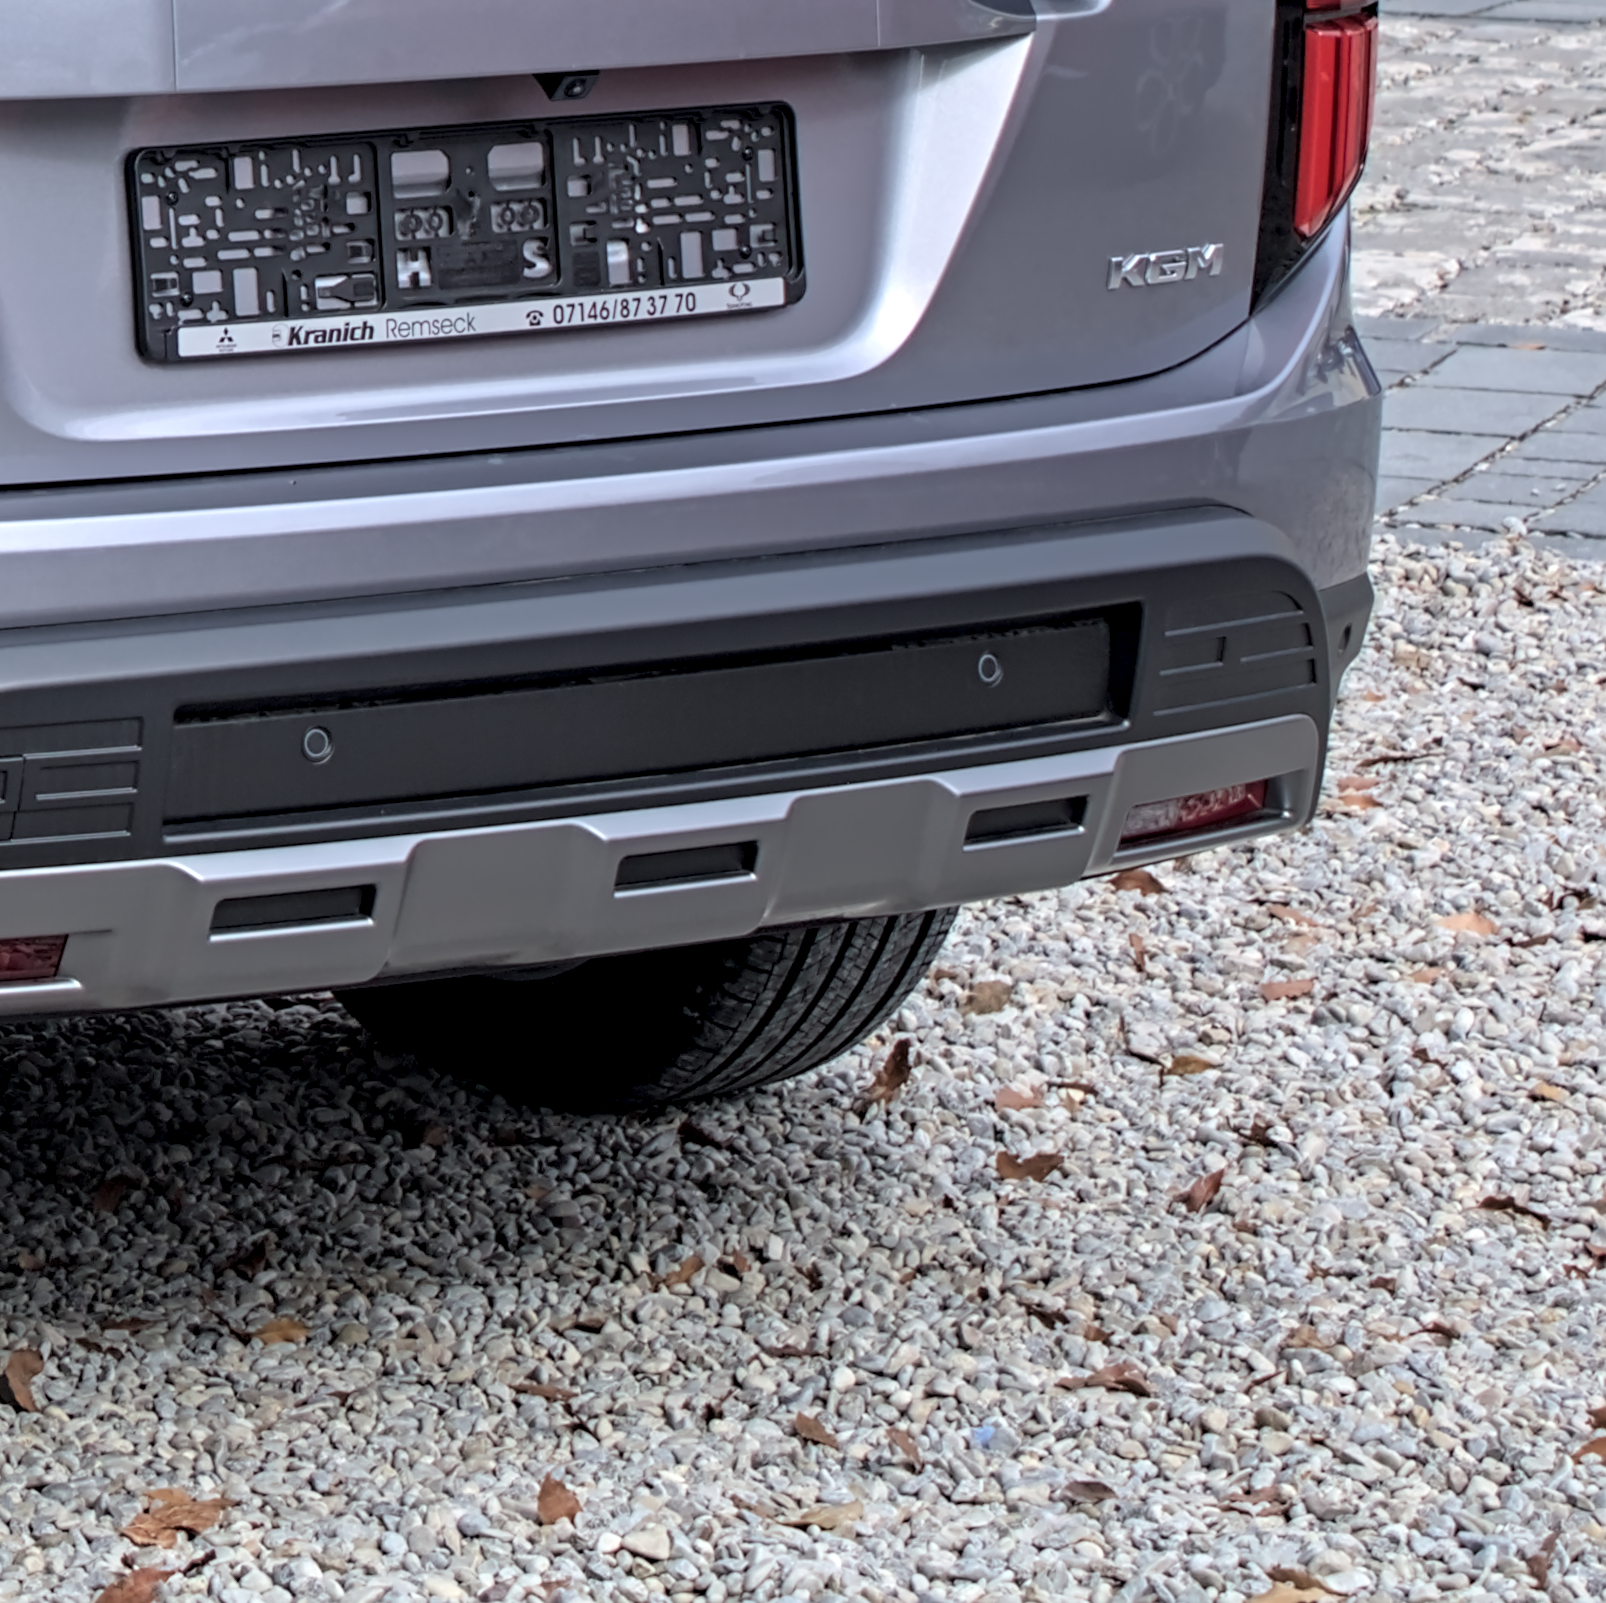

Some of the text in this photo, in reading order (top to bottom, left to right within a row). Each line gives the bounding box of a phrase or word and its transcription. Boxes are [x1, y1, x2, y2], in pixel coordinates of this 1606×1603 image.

[1106, 242, 1225, 291] KGM
[552, 292, 697, 325] 07146/87 37 70
[287, 312, 477, 347] Kranich Remseck
